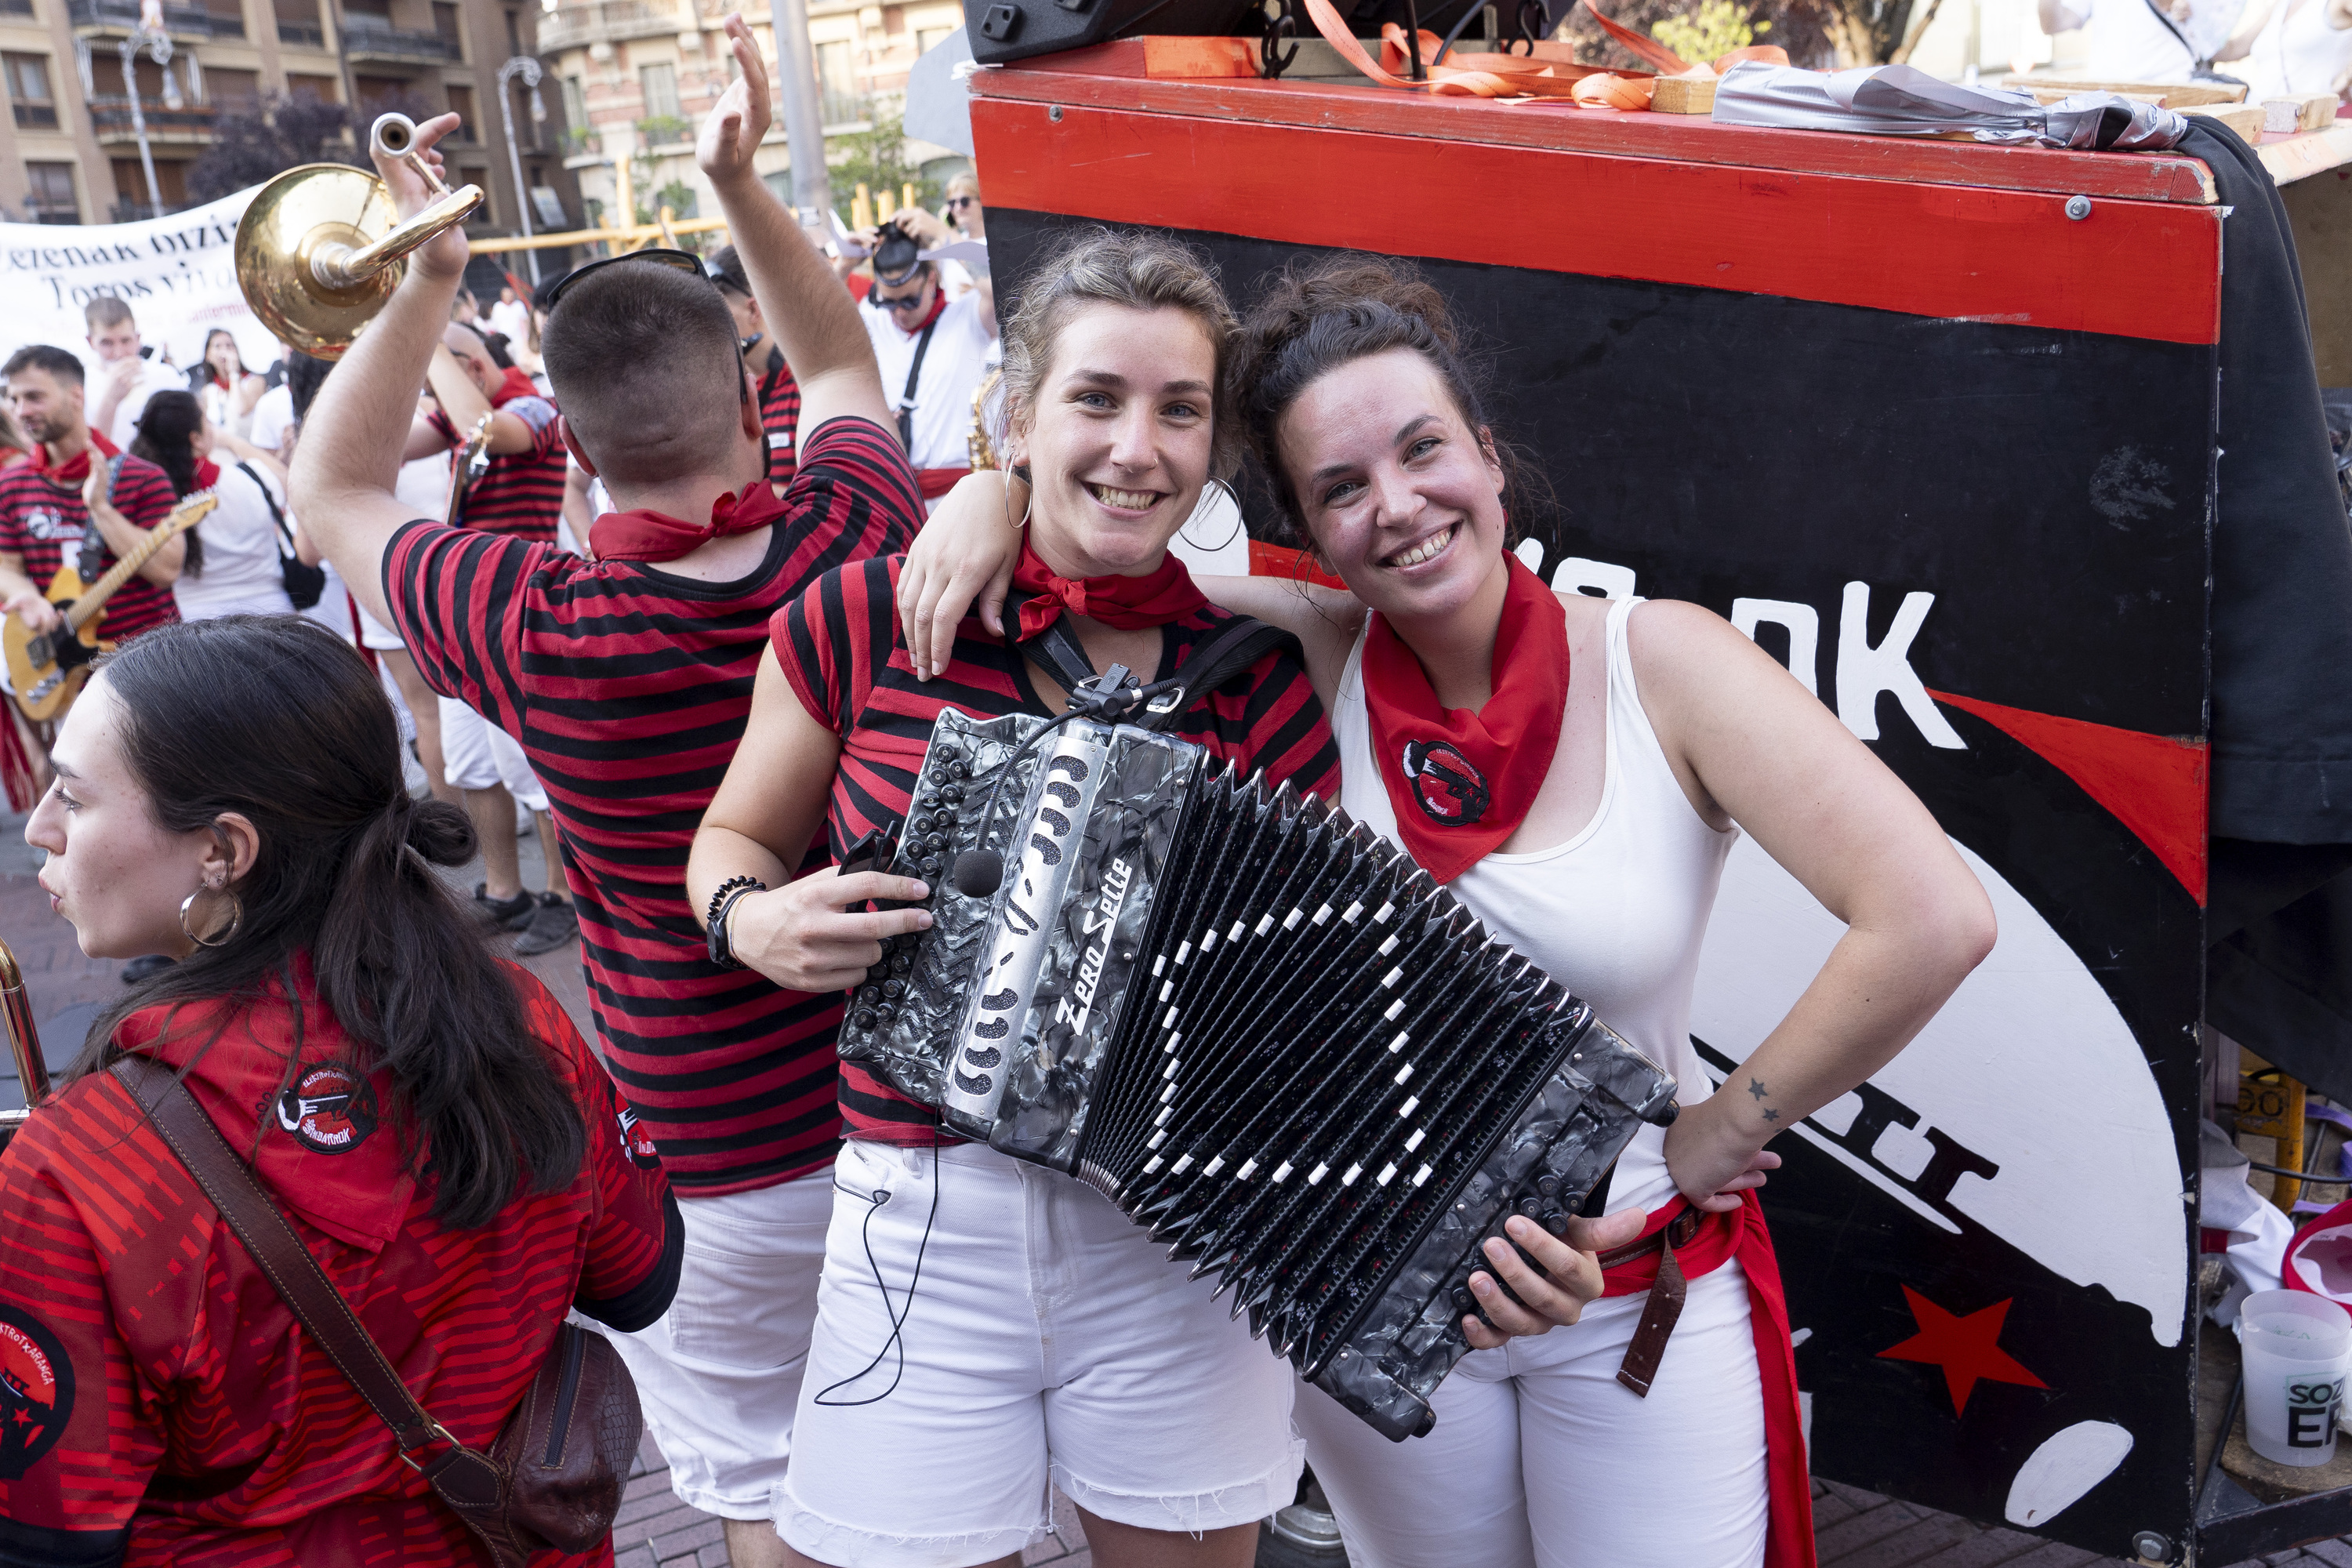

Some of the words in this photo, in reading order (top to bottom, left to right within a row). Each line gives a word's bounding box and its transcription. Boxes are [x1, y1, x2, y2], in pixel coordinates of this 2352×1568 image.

[8, 241, 142, 270] ezenak
[41, 274, 153, 309] Toros
[1082, 857, 1133, 946] Sette
